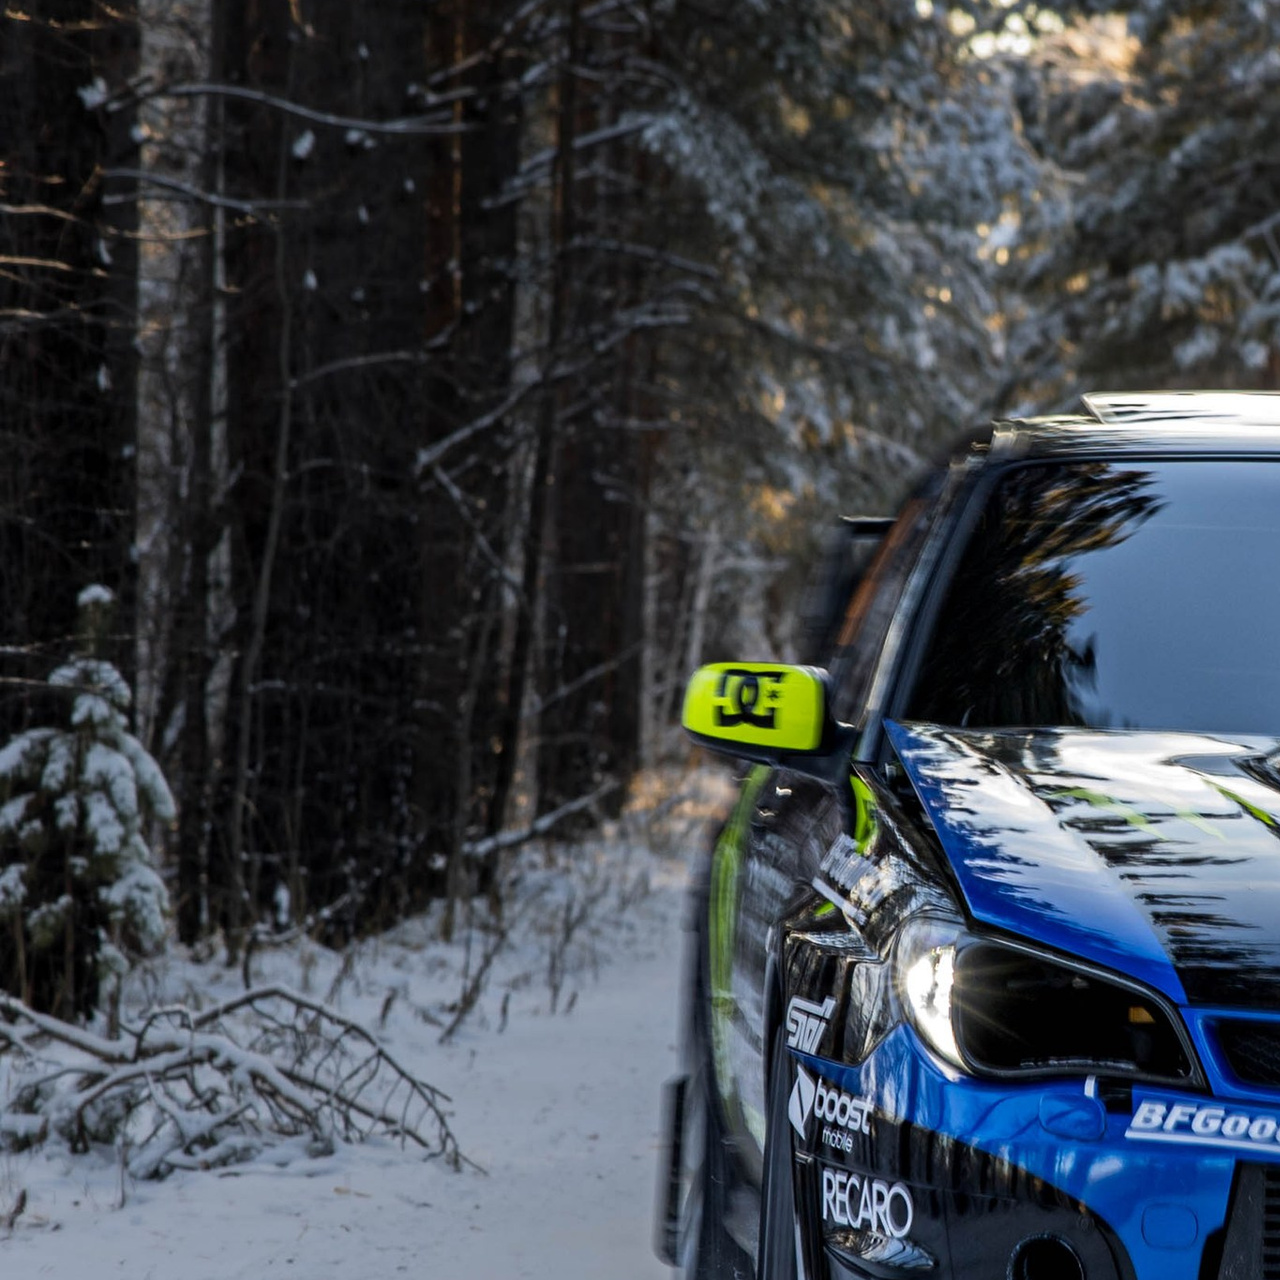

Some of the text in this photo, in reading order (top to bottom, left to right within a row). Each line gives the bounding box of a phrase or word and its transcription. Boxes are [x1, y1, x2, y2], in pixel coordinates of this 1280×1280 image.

[814, 1076, 874, 1135] boost
[822, 1127, 853, 1152] mobile
[823, 1168, 913, 1238] RECARO
